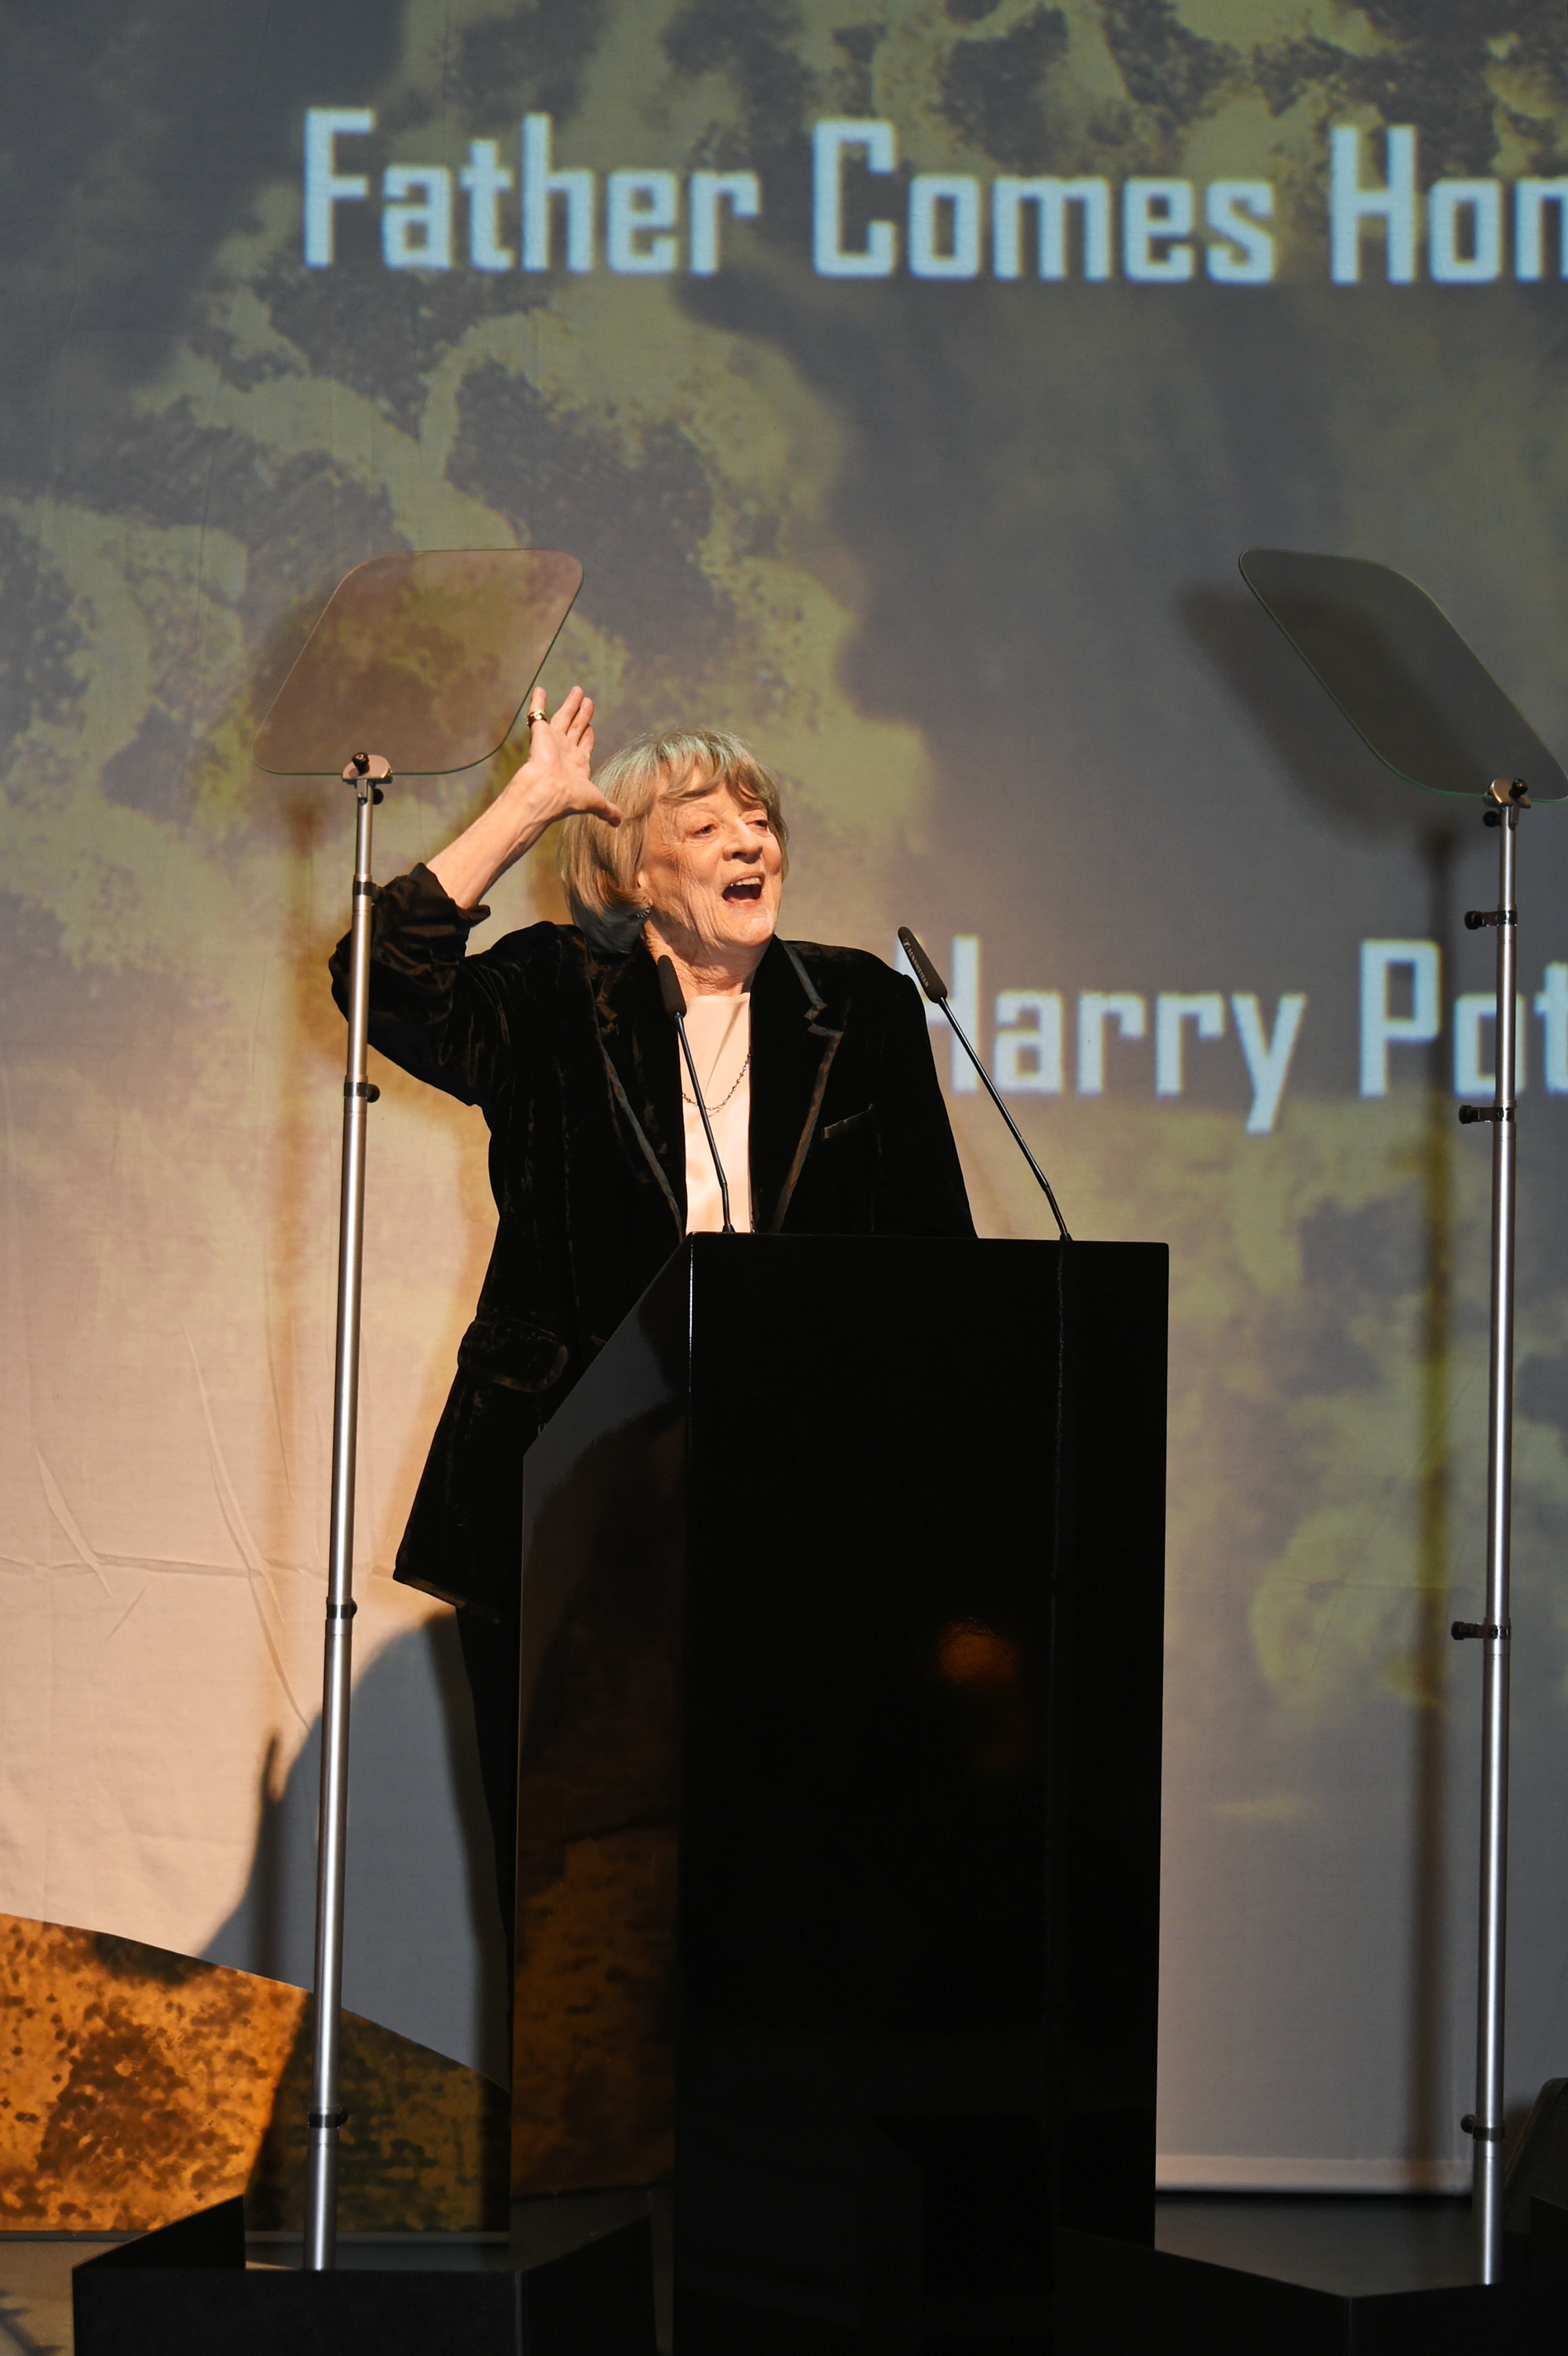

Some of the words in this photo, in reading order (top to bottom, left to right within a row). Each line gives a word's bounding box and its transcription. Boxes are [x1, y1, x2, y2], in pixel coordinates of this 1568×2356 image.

[303, 107, 760, 276] Father
[811, 118, 1275, 285] Comes
[895, 934, 1307, 1138] Harry
